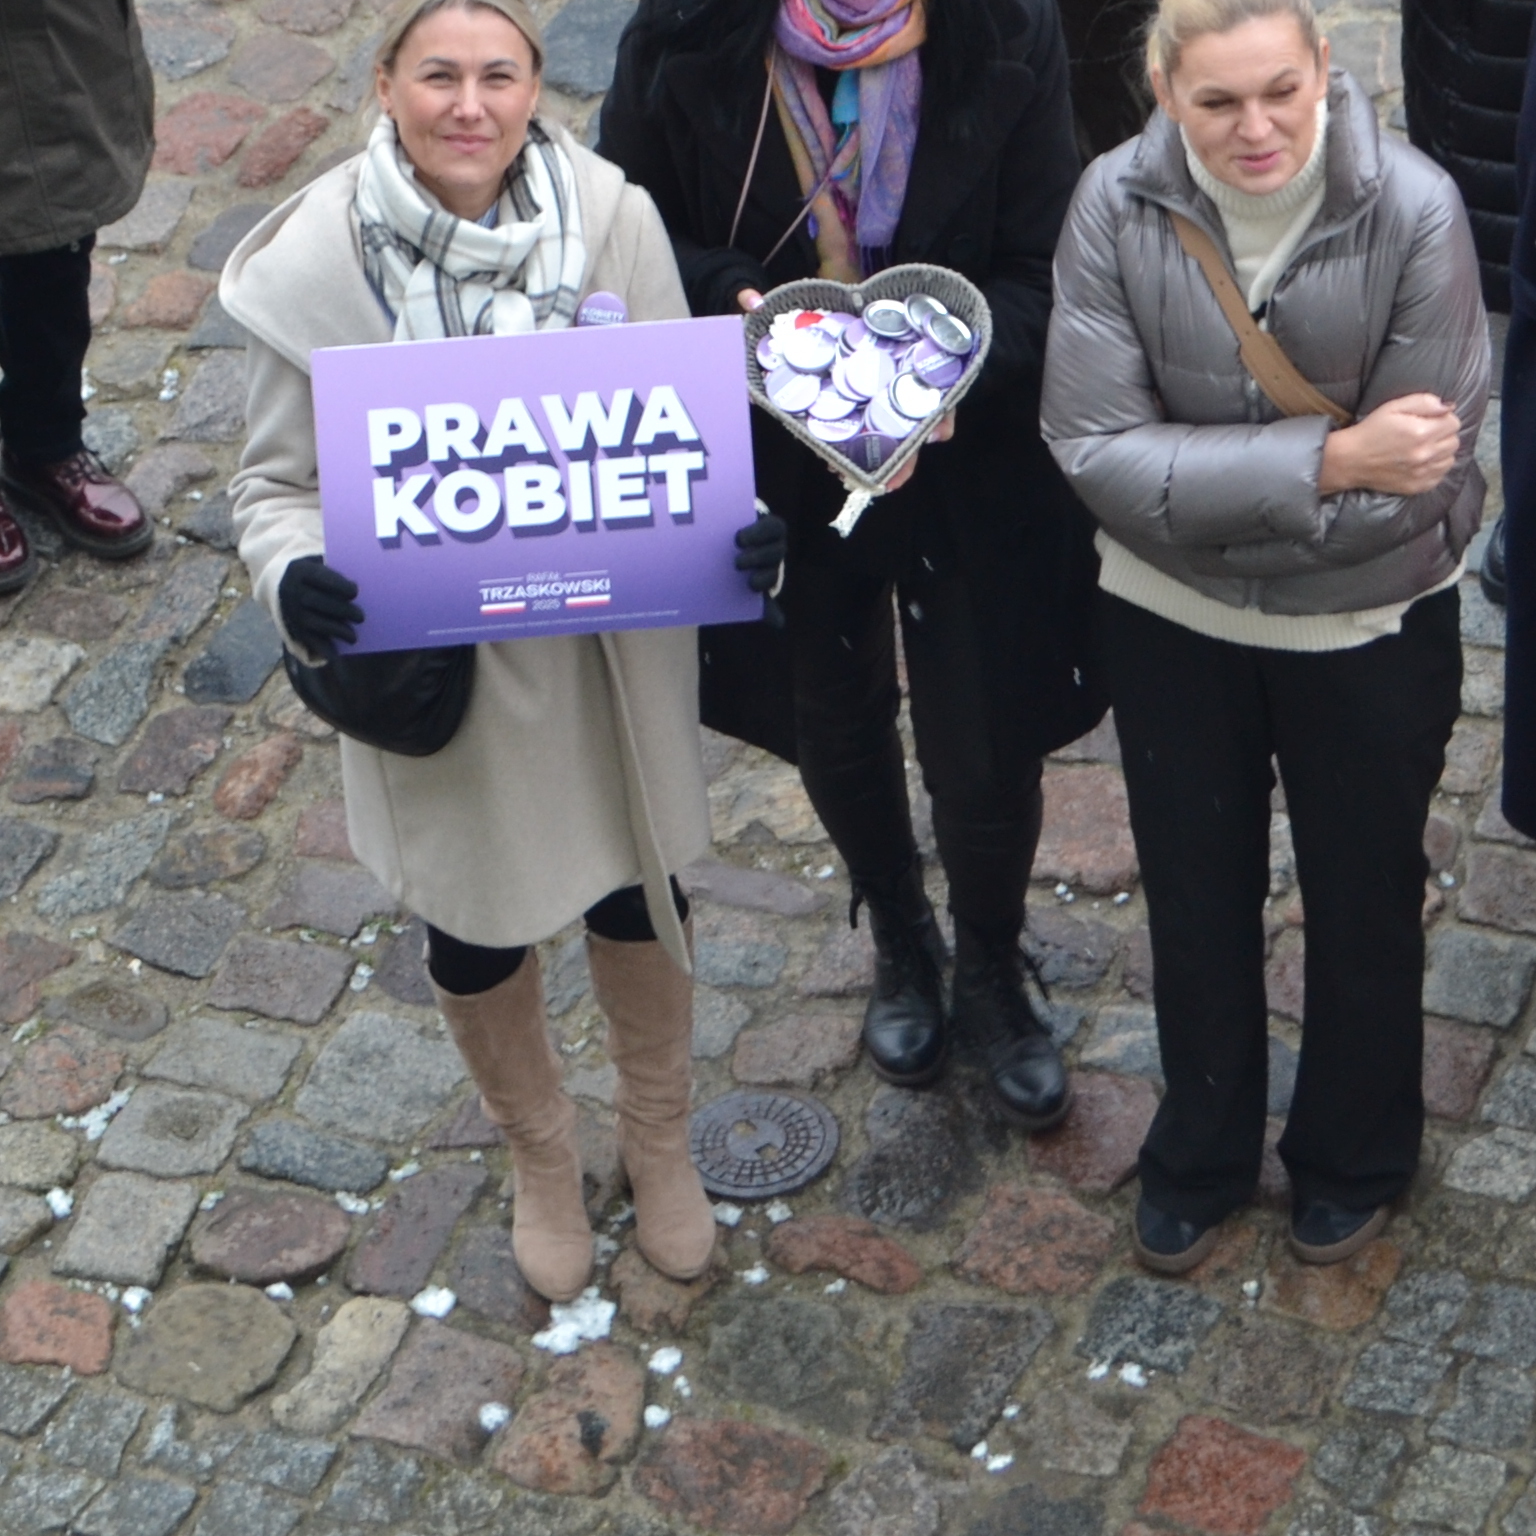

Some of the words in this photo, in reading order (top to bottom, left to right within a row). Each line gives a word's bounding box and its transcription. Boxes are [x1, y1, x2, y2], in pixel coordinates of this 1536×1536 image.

[367, 385, 700, 467] PRAWA
[372, 451, 705, 539] KOBIET
[478, 577, 611, 602] TRZASKOWSKI
